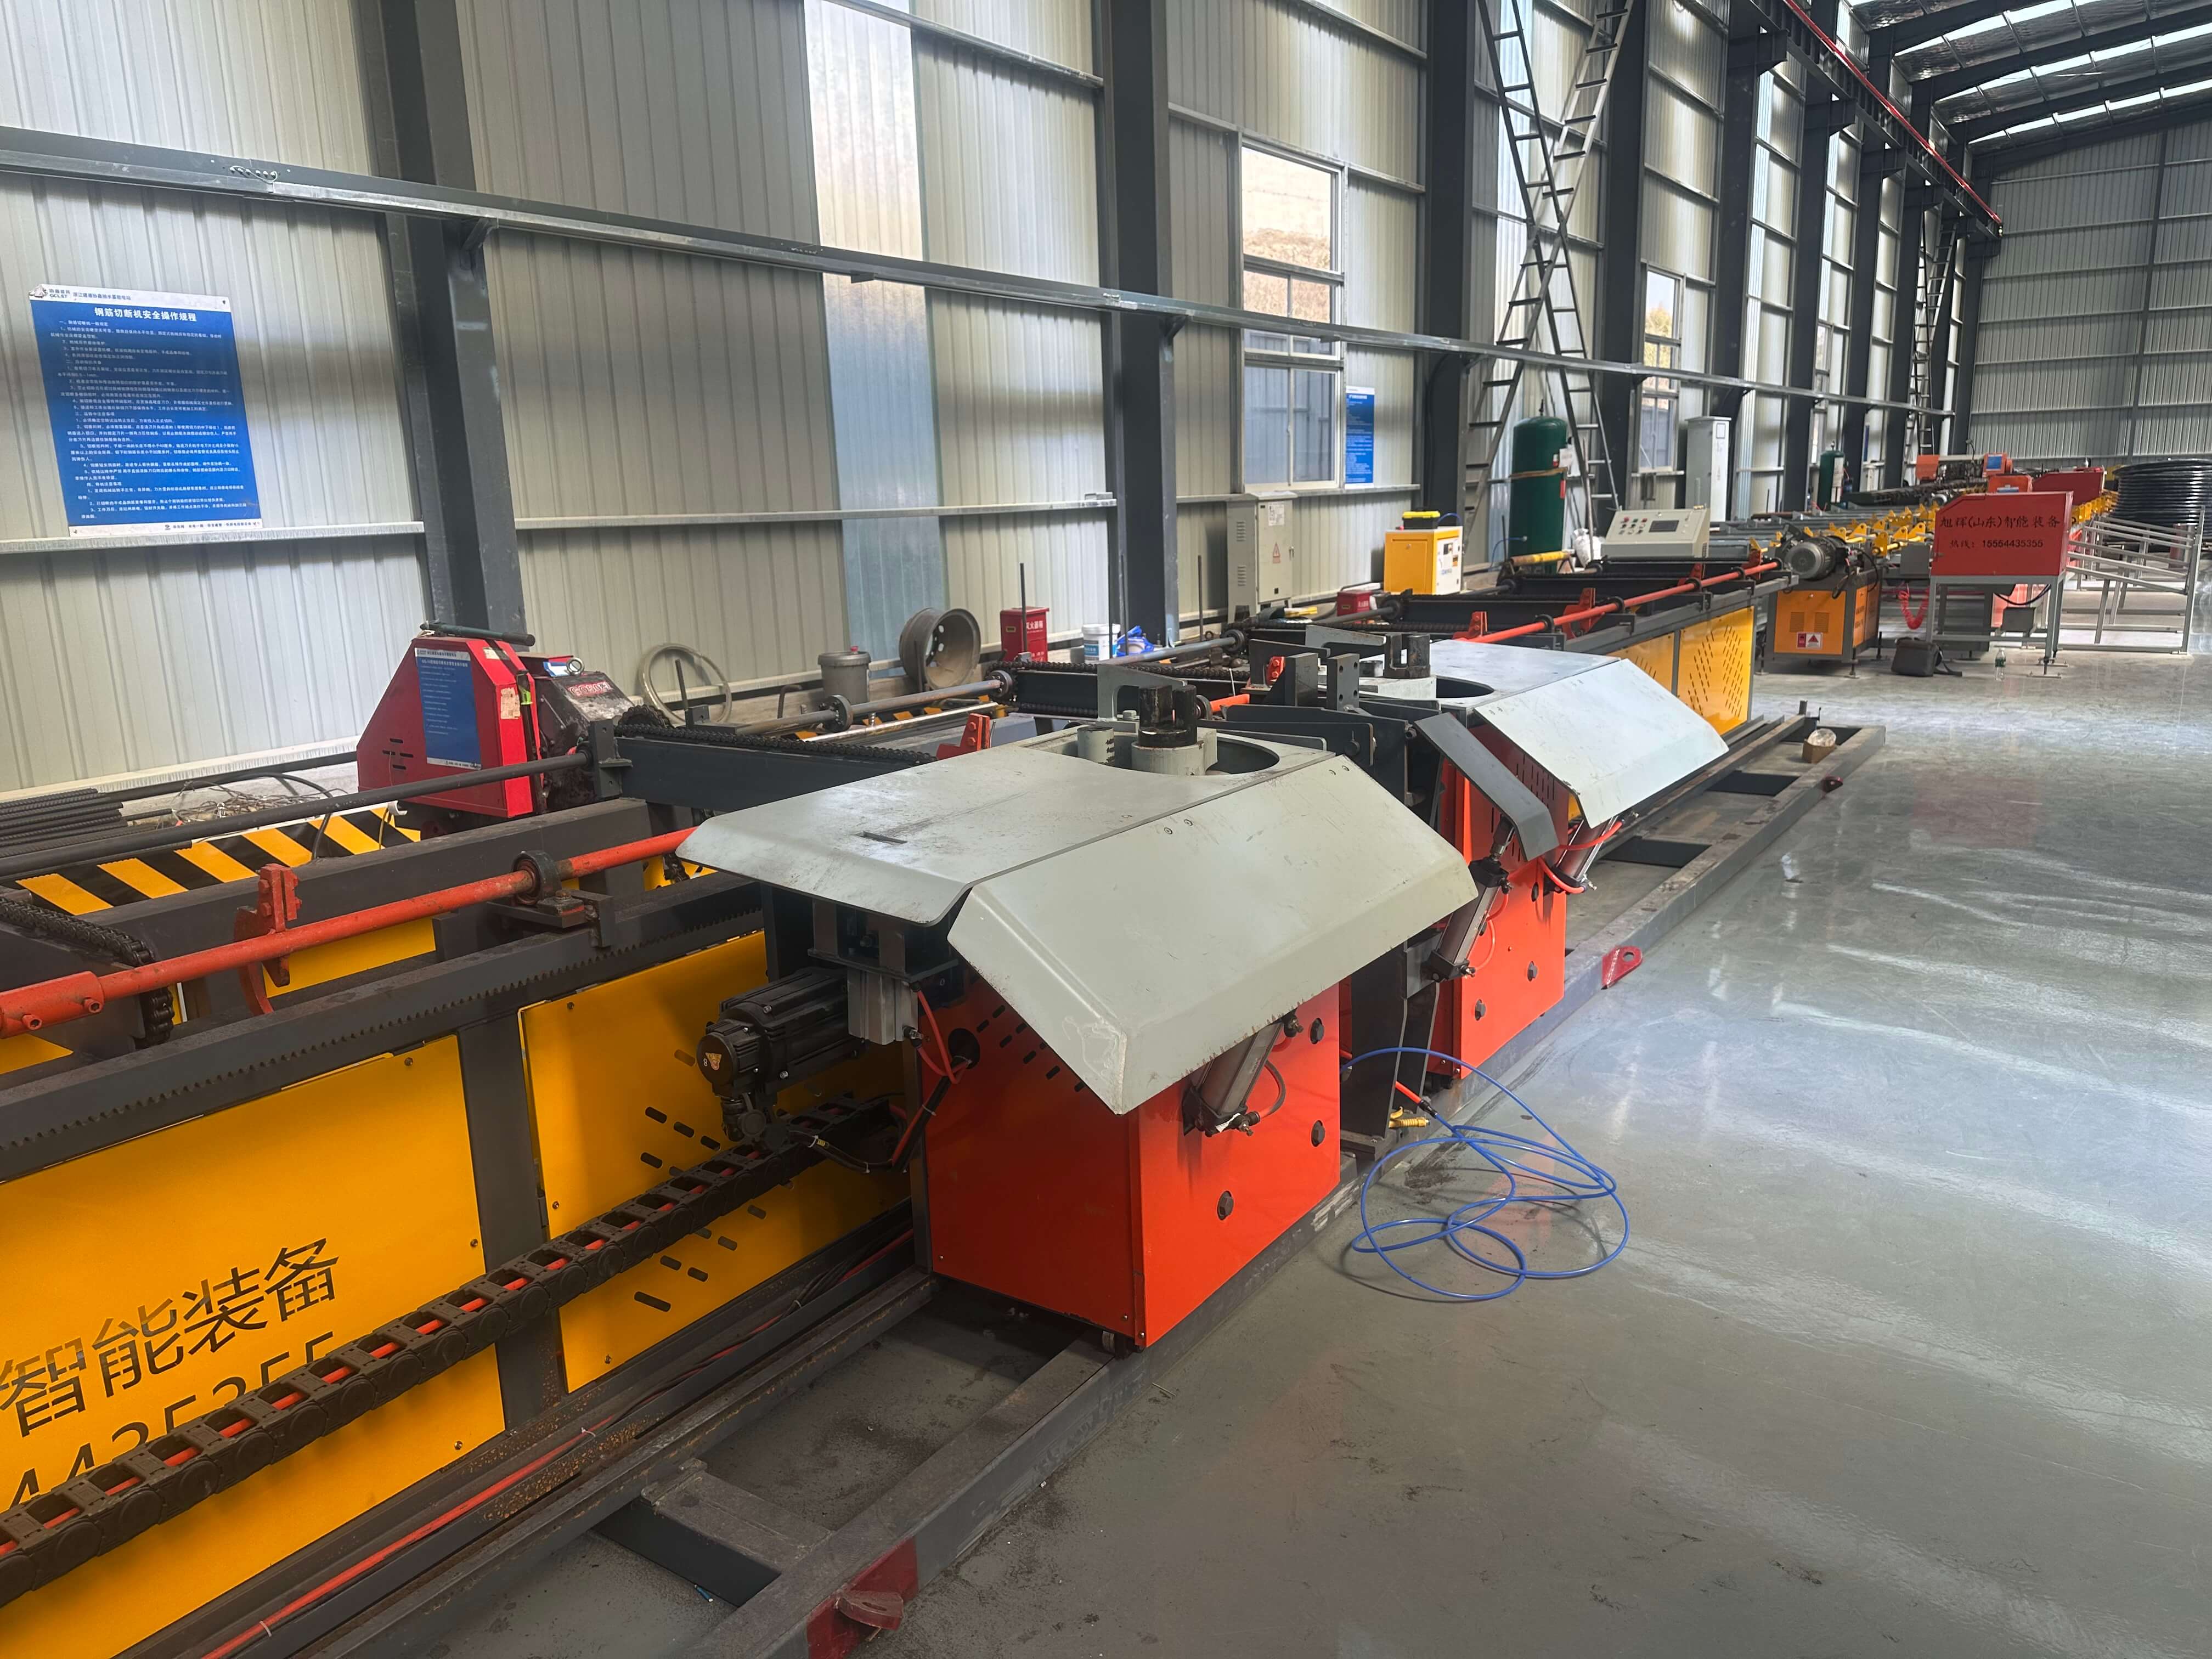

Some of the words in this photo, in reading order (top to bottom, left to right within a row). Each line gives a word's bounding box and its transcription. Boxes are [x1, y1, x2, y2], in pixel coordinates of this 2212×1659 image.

[94, 307, 198, 322] 钢筋切断机安全操作规程
[1982, 539, 2044, 548] 15554435355
[0, 1238, 339, 1438] 智能装备
